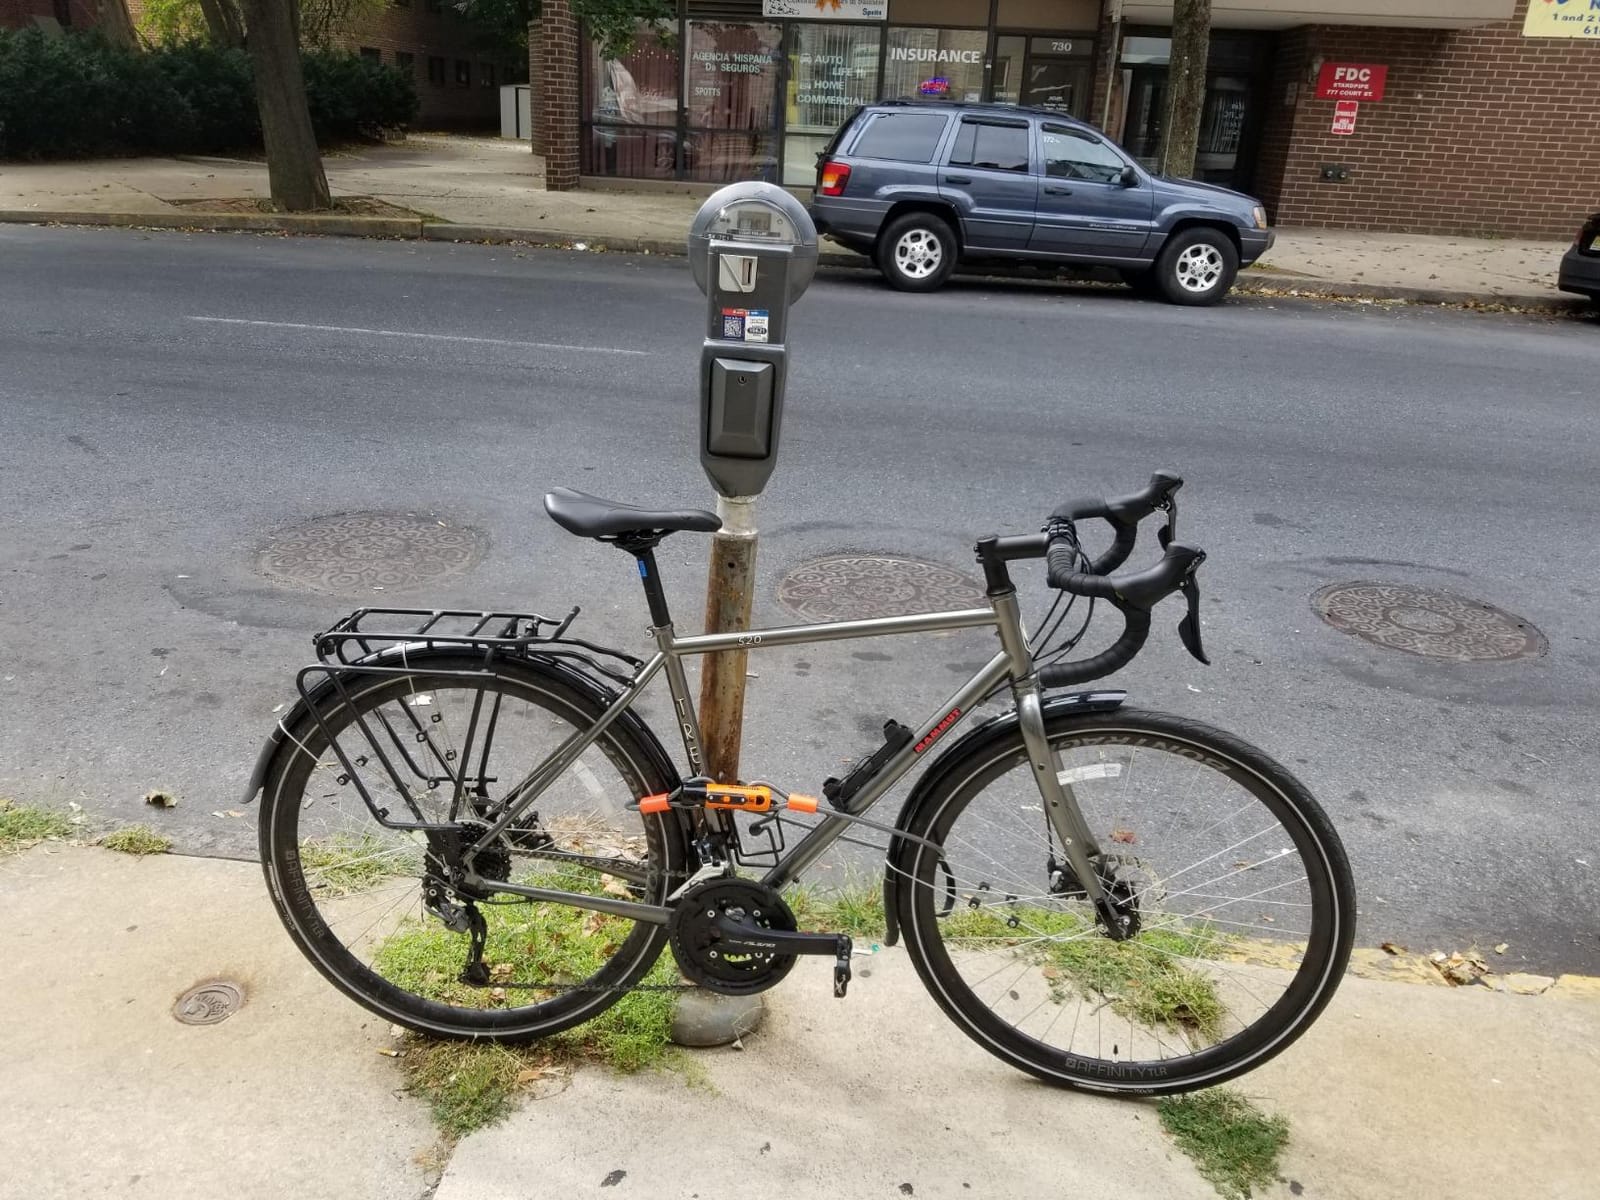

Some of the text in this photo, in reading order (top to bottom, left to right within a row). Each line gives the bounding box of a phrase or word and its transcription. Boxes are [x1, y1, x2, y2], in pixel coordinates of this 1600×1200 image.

[1583, 26, 1600, 34] 61
[1051, 42, 1072, 51] 730
[692, 52, 773, 64] AGENCIA HISPANA
[814, 55, 844, 65] AUTO
[890, 48, 981, 64] INSURANCE
[720, 63, 761, 73] SEGUROS
[832, 67, 853, 76] LIFE
[1335, 67, 1371, 82] FDC
[814, 80, 845, 90] HOME
[920, 80, 949, 92] OPEN
[695, 87, 721, 96] SPOTTS
[796, 95, 865, 106] COMMERCIAL
[737, 635, 762, 646] 520
[286, 860, 317, 920] AFFINITY
[1076, 1061, 1148, 1078] AFFINITY
